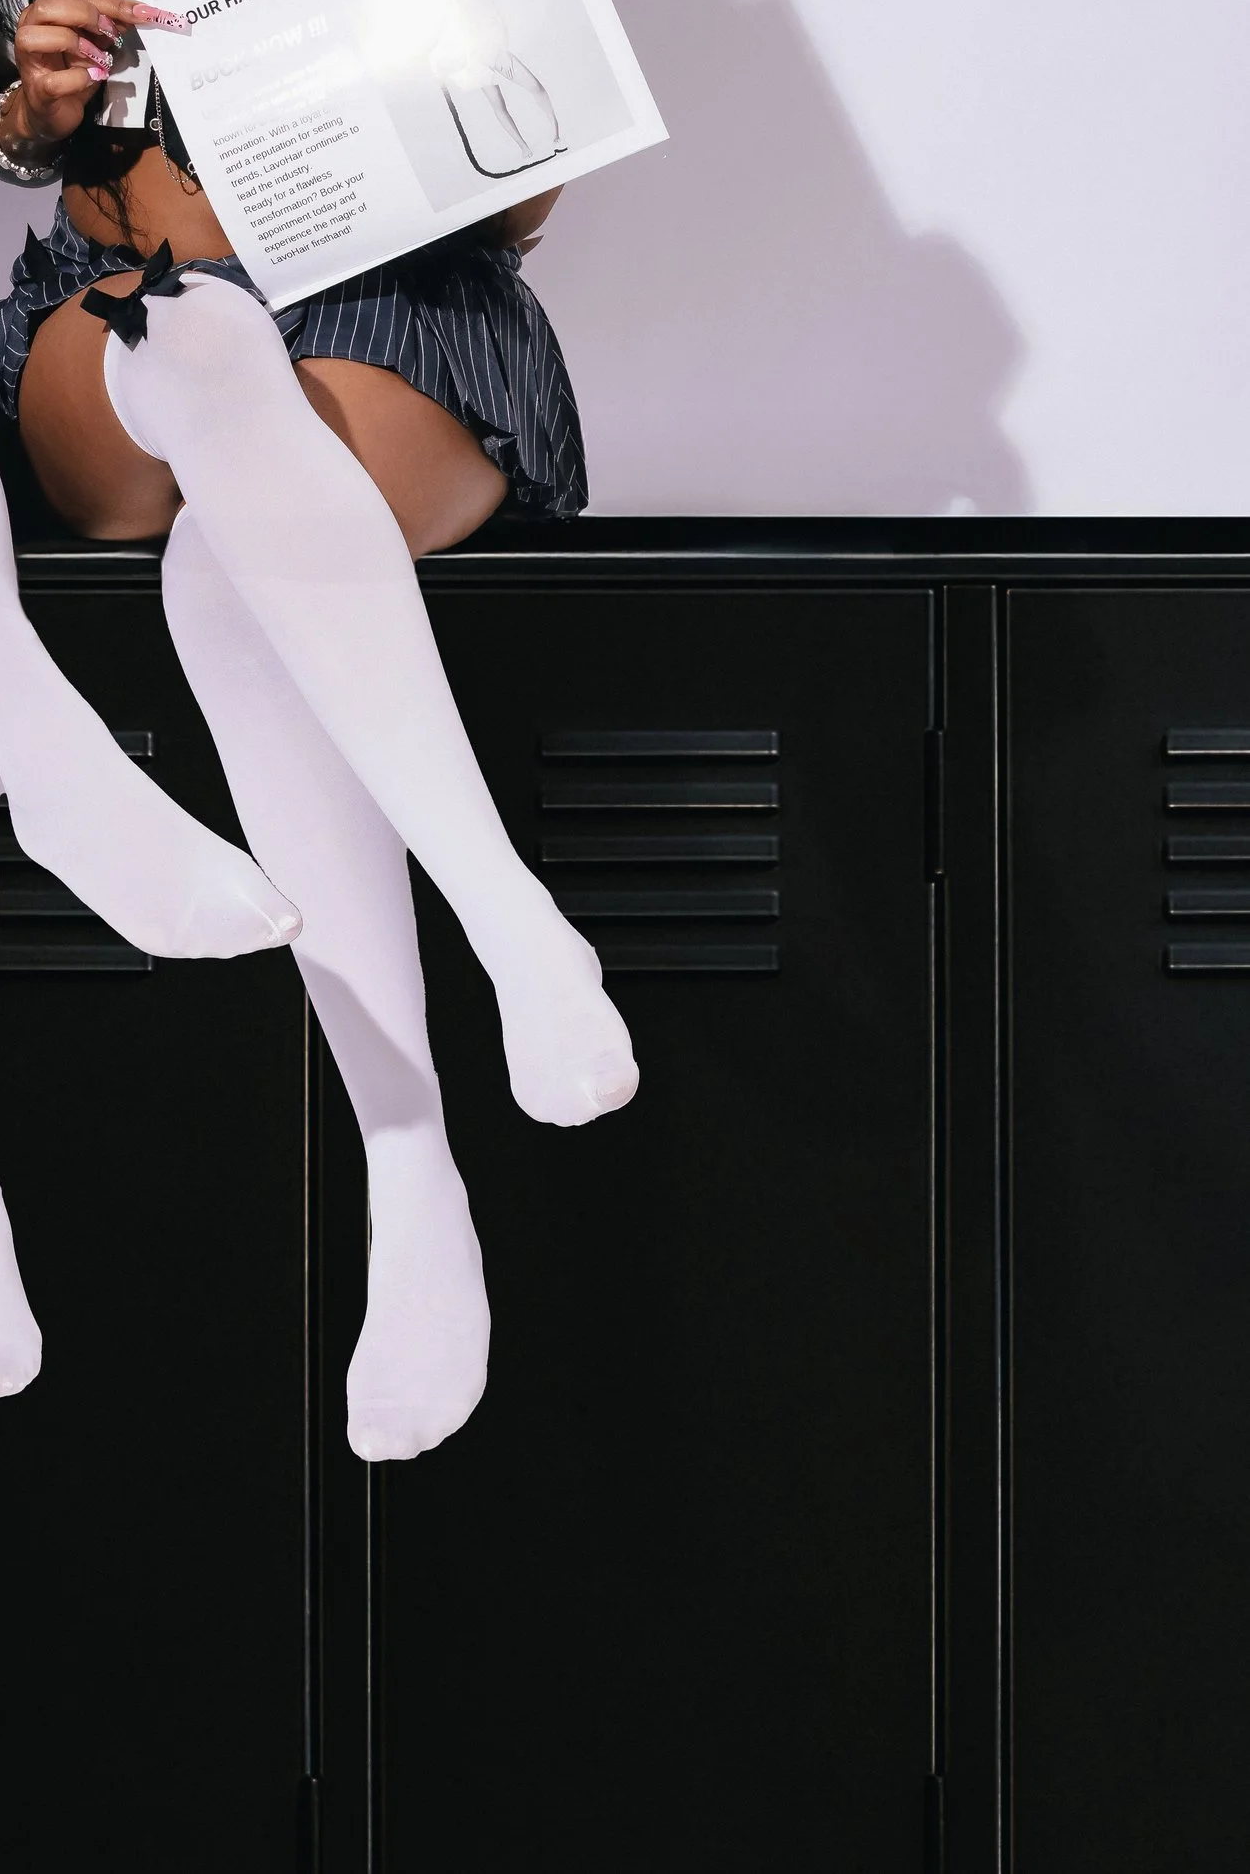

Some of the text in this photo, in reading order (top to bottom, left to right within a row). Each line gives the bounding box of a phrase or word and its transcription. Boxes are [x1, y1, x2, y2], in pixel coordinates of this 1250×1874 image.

[225, 117, 344, 175] and a reputation for setting
[262, 150, 303, 174] LavoHair
[305, 130, 349, 155] continues
[349, 125, 360, 135] to
[268, 124, 290, 138] With
[292, 121, 299, 129] a
[236, 186, 258, 202] lead
[257, 181, 274, 192] the
[243, 170, 333, 215] Ready for a flawless
[250, 172, 364, 229] transformation? Book your
[257, 191, 357, 241] appointment today and
[264, 202, 367, 254] experience the magic of
[270, 225, 353, 265] LavoHair firsthand!
